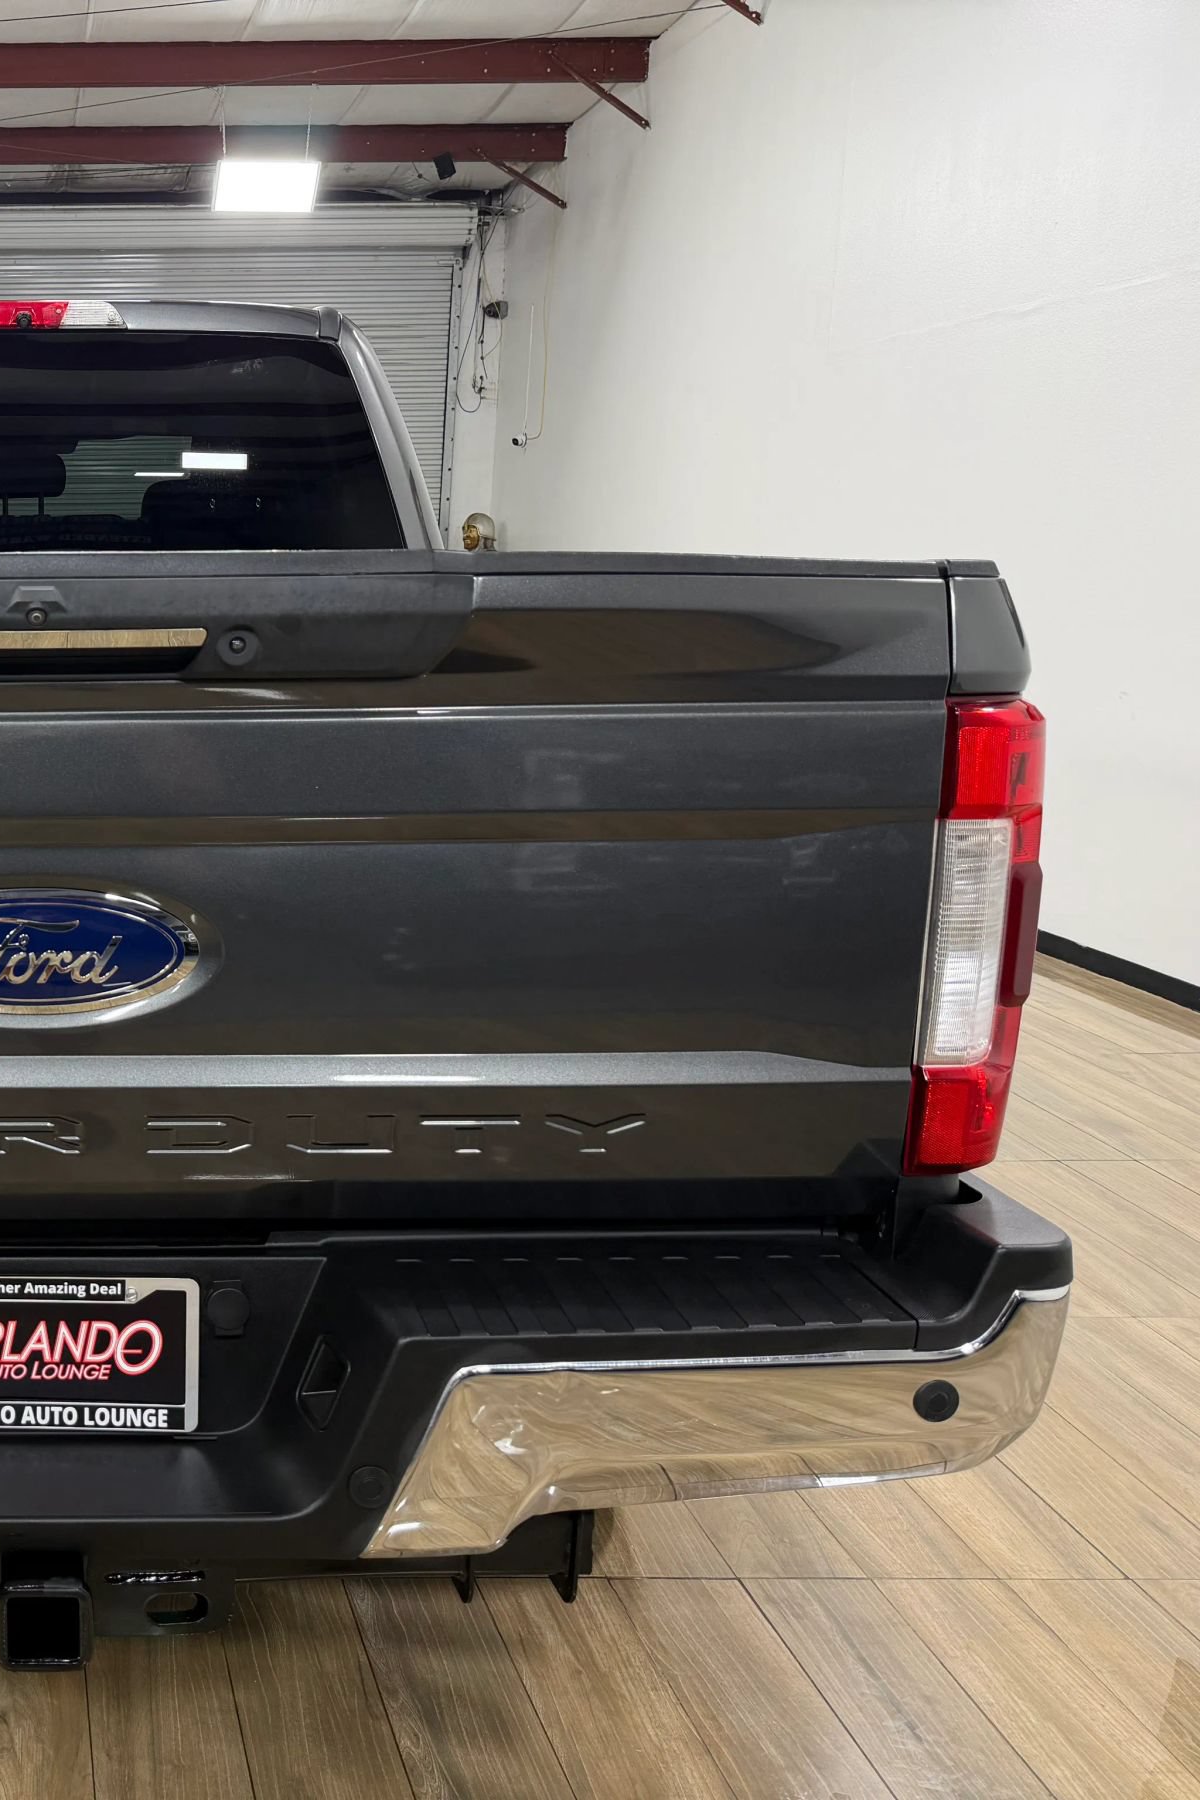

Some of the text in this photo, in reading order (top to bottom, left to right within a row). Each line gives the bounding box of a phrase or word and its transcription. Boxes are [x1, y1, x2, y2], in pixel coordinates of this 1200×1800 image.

[144, 1112, 647, 1154] DUTY
[23, 1282, 87, 1297] Amazing
[89, 1283, 122, 1295] Deal
[30, 1361, 113, 1380] LOUNGE
[20, 1406, 78, 1425] AUTO
[83, 1407, 169, 1428] LOUNGE
